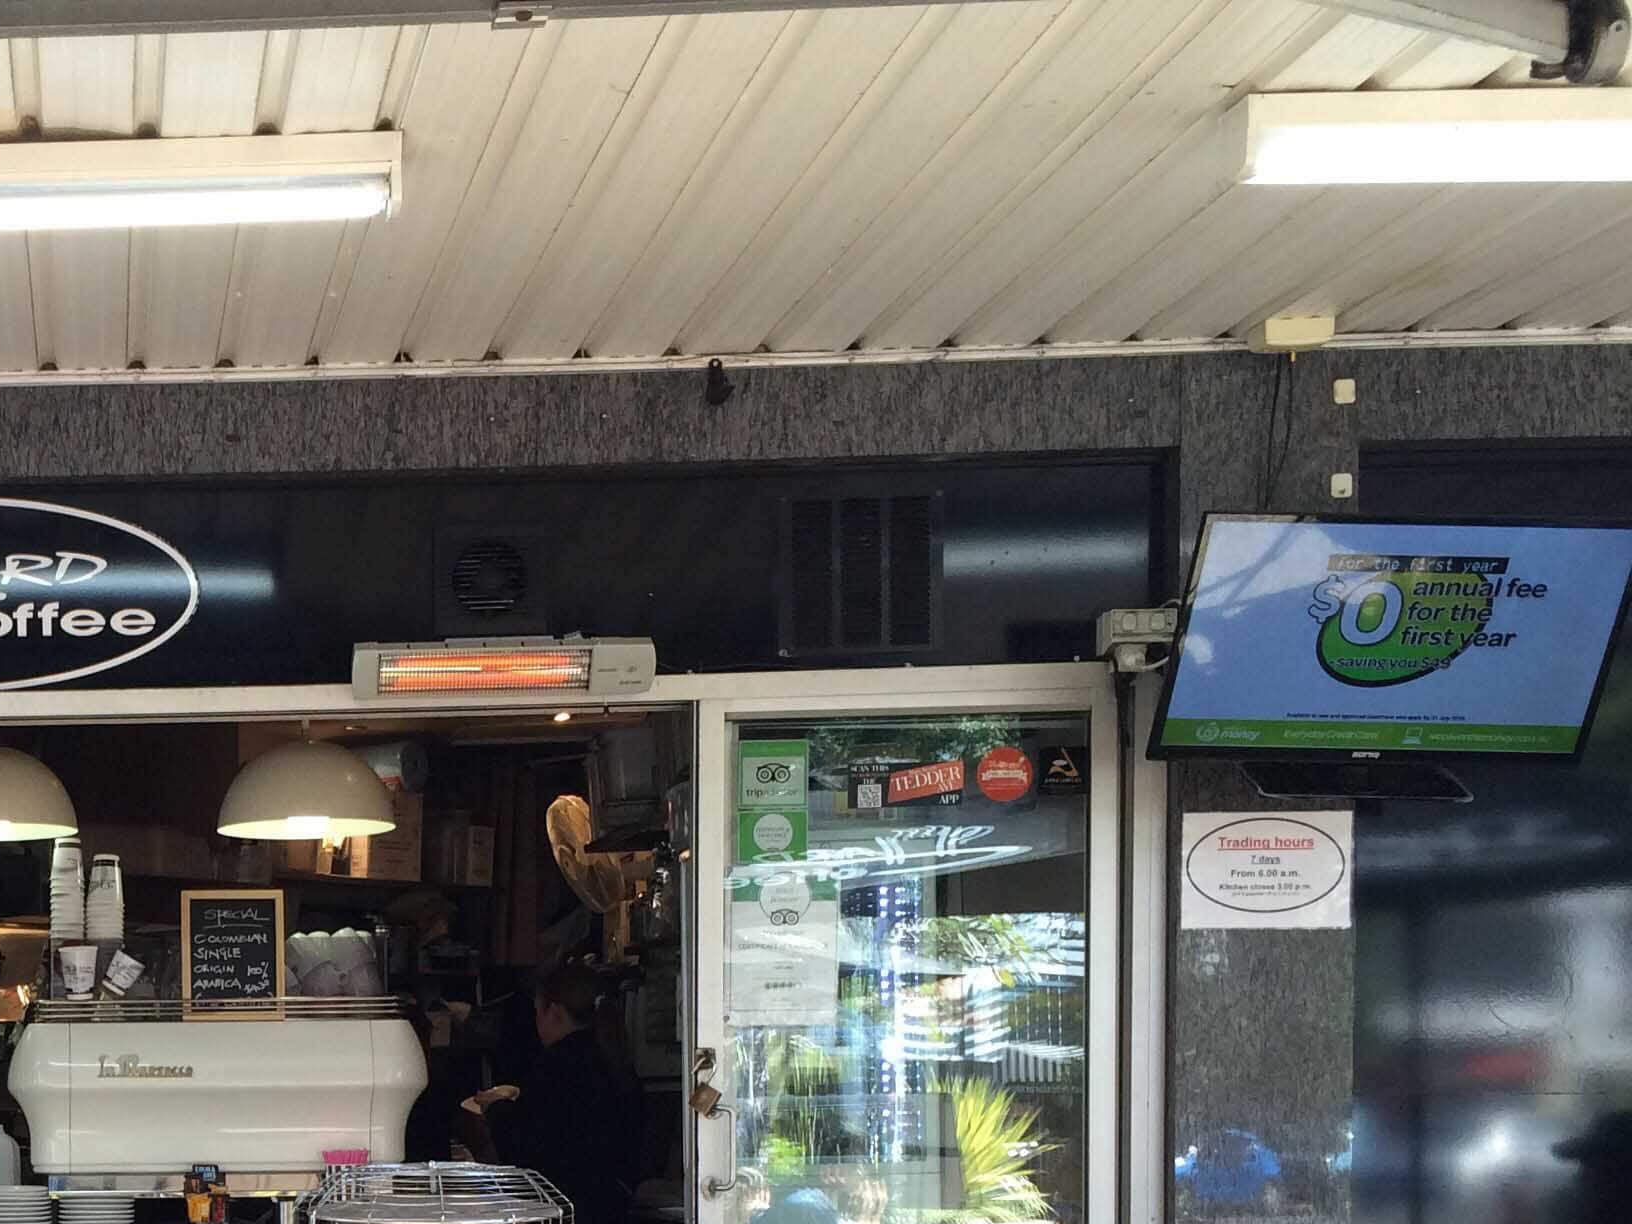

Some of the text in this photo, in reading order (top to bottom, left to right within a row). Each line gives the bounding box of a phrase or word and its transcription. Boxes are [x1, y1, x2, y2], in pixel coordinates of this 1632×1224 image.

[1374, 558, 1401, 571] the
[1462, 559, 1498, 574] year
[1413, 577, 1548, 598] annual fee
[1407, 602, 1493, 623] for the
[1400, 625, 1517, 652] first year
[1336, 656, 1386, 671] saving
[1390, 657, 1418, 672] you
[892, 765, 962, 792] TEDDER
[938, 793, 960, 805] APP
[1219, 836, 1314, 850] Trading hours
[1258, 855, 1281, 866] days
[1231, 869, 1255, 878] From
[203, 908, 270, 928] SPECIAL
[193, 947, 241, 960] SINGLE
[193, 964, 234, 975] ORIGIN
[193, 978, 241, 990] ARABICA
